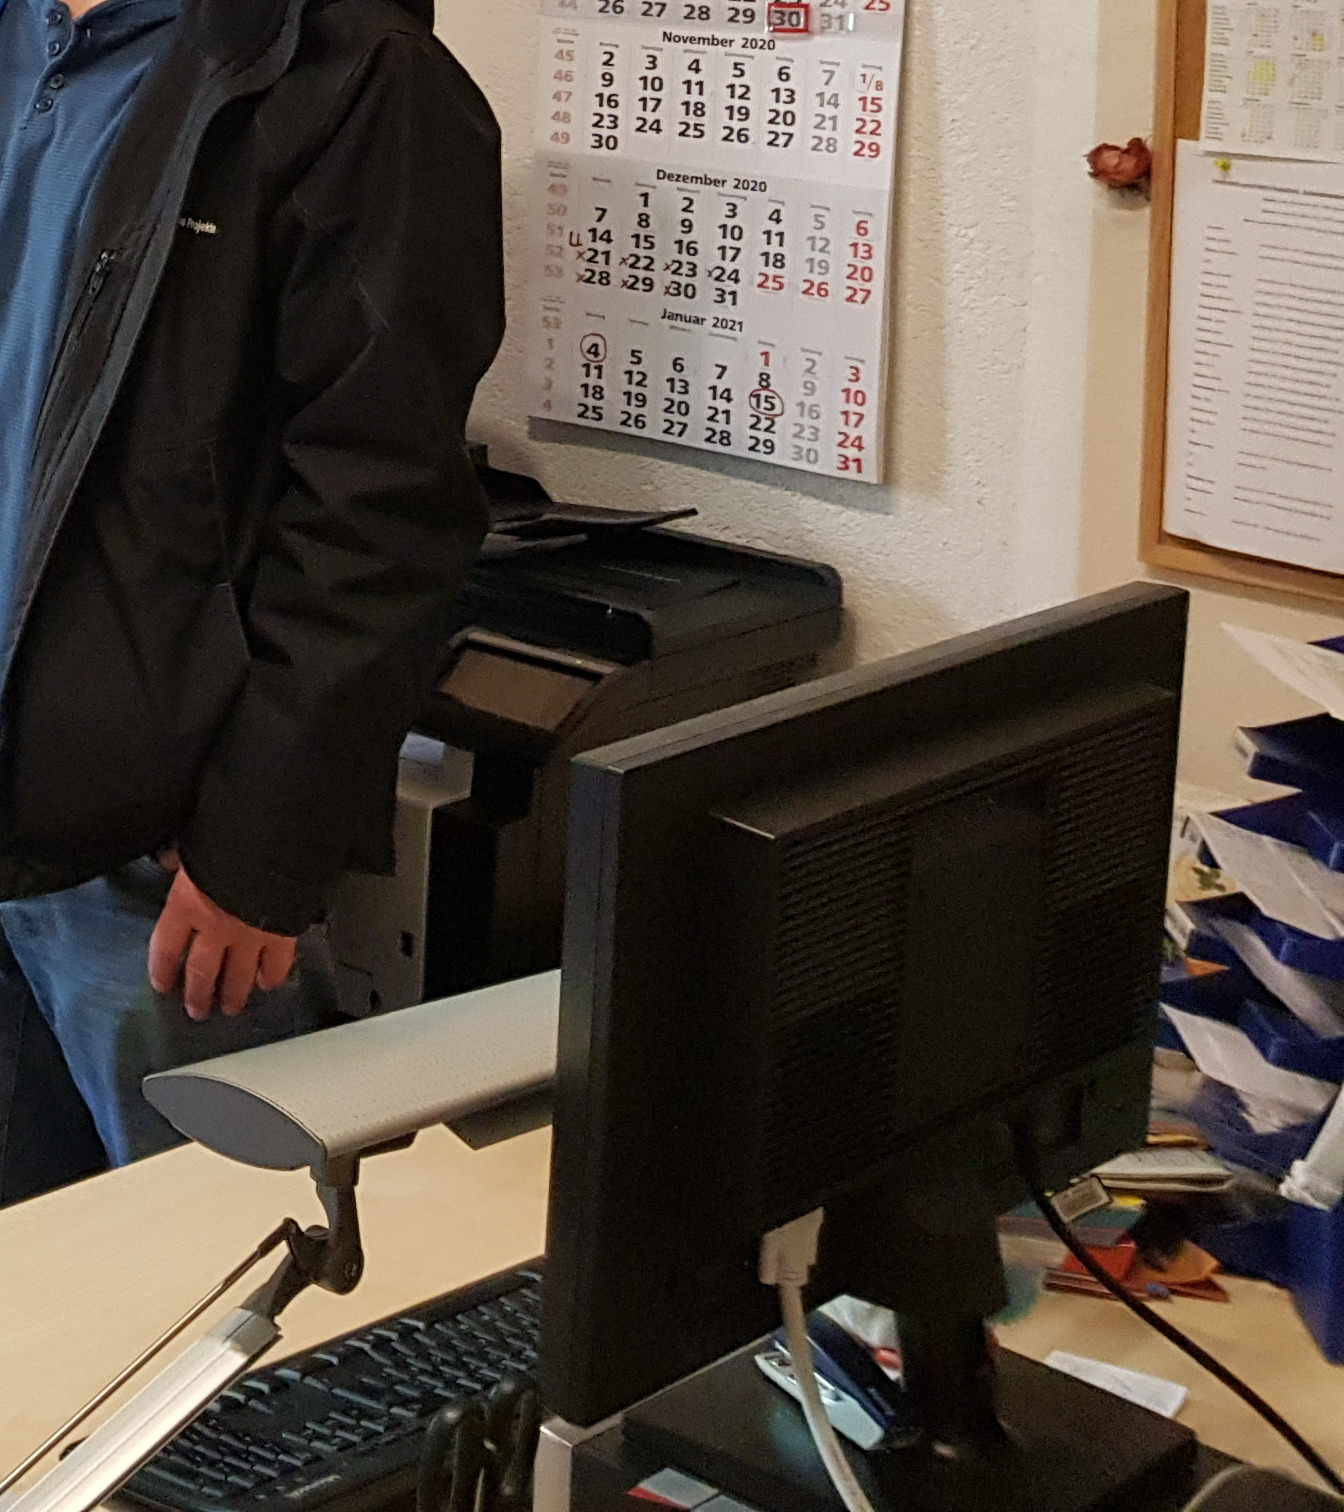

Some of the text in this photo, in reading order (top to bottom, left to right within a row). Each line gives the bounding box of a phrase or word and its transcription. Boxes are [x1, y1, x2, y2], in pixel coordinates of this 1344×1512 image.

[641, 1, 667, 18] 27
[683, 4, 710, 21] 28
[727, 7, 756, 24] 29
[771, 10, 802, 30] 30
[662, 31, 776, 51] November 2020
[602, 51, 884, 91] 2 3 4 5 6 1/8
[601, 72, 882, 113] 9 10 11 12 13 15
[595, 92, 881, 136] 16 17 18 19 20 22
[591, 133, 618, 150] 30
[592, 113, 880, 158] 23 24 25 26 27 29
[655, 168, 768, 193] Dezember 2020
[595, 207, 873, 260] 7 8 9 10 11 13
[639, 192, 869, 237] 1 2 3 4 6
[588, 227, 873, 283] 14 15 16 17 18 20
[713, 287, 737, 306] 31
[757, 272, 872, 304] 25 26 27
[660, 307, 744, 333] Januar 2021
[586, 343, 866, 407] 4 5 6 7 8 10
[760, 351, 861, 383] 1 3
[581, 363, 865, 428] 11 12 13 14 15 17
[580, 383, 865, 452] 18 19 20 21 22 24
[577, 403, 862, 474] 25 26 27 28 29 31
